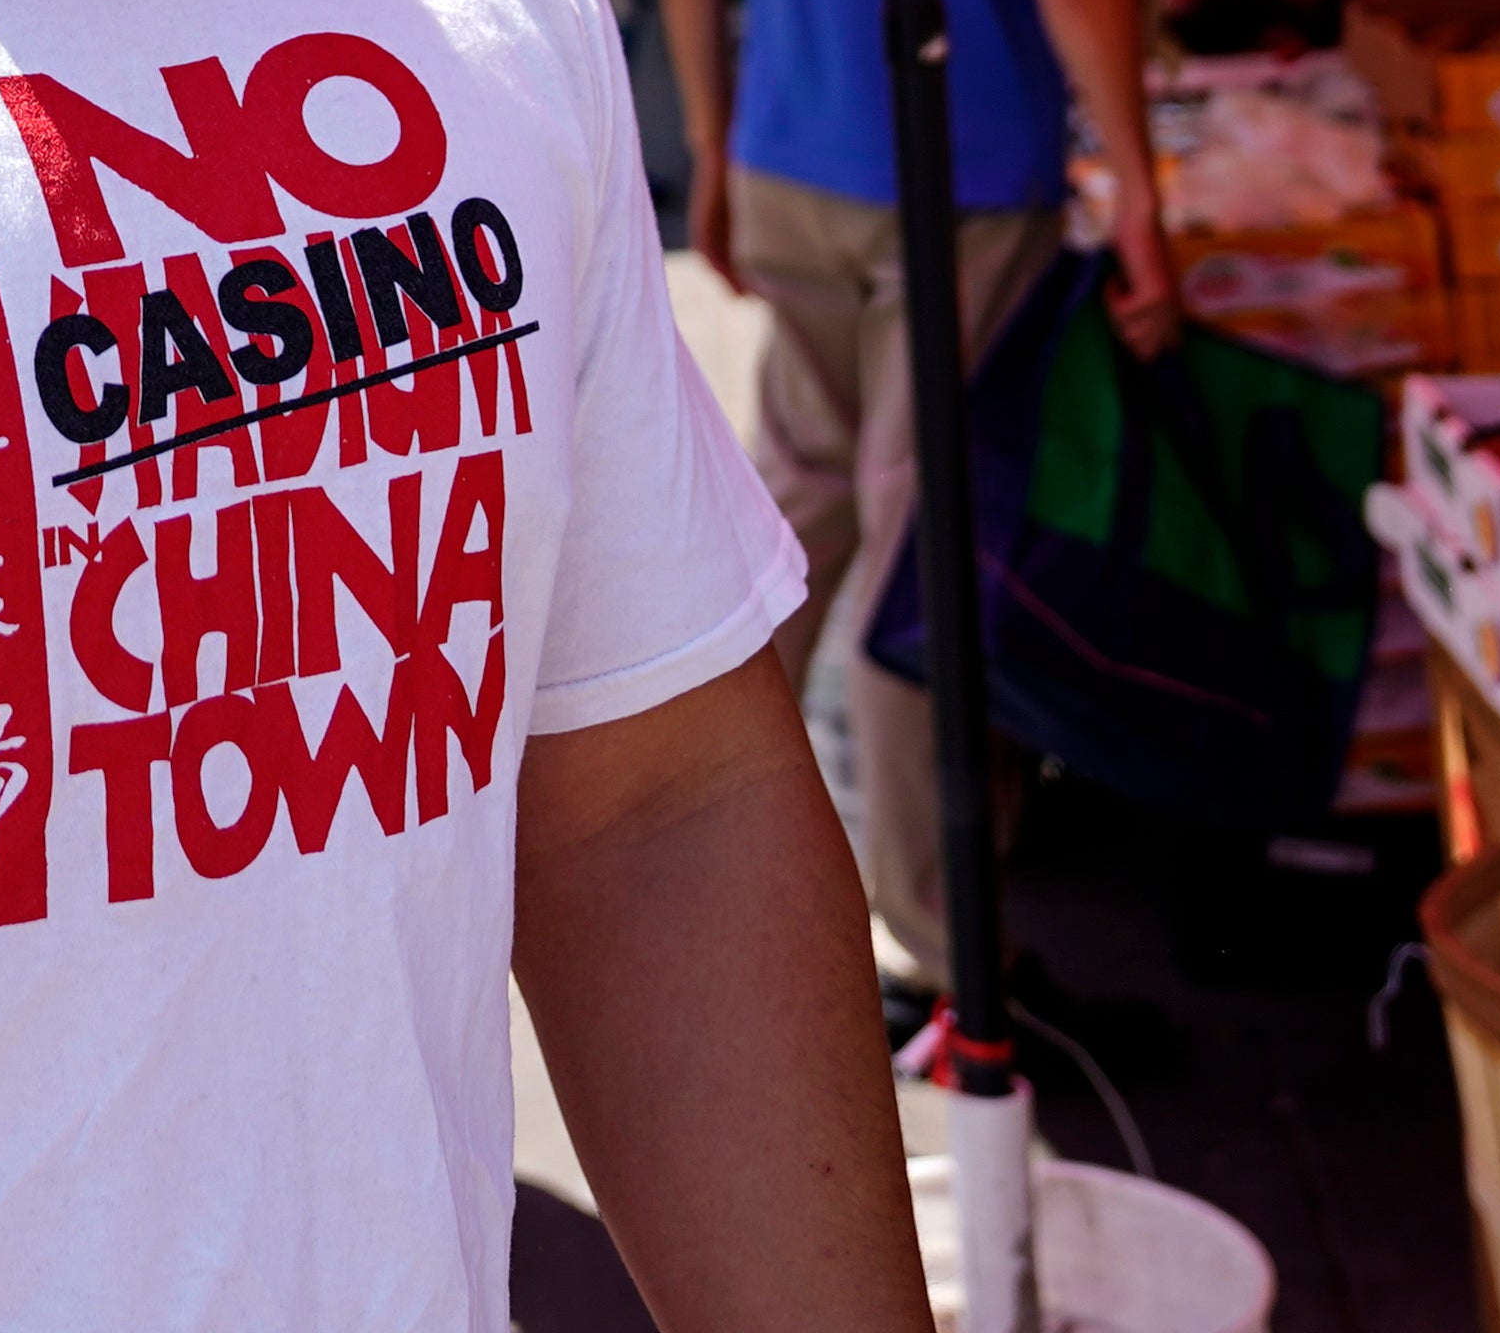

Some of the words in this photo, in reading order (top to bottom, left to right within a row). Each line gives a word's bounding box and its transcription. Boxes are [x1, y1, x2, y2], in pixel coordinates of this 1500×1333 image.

[34, 197, 524, 444] CASINO
[42, 522, 103, 569] IN
[69, 449, 505, 714] CHINA
[68, 622, 506, 904] TOWN
